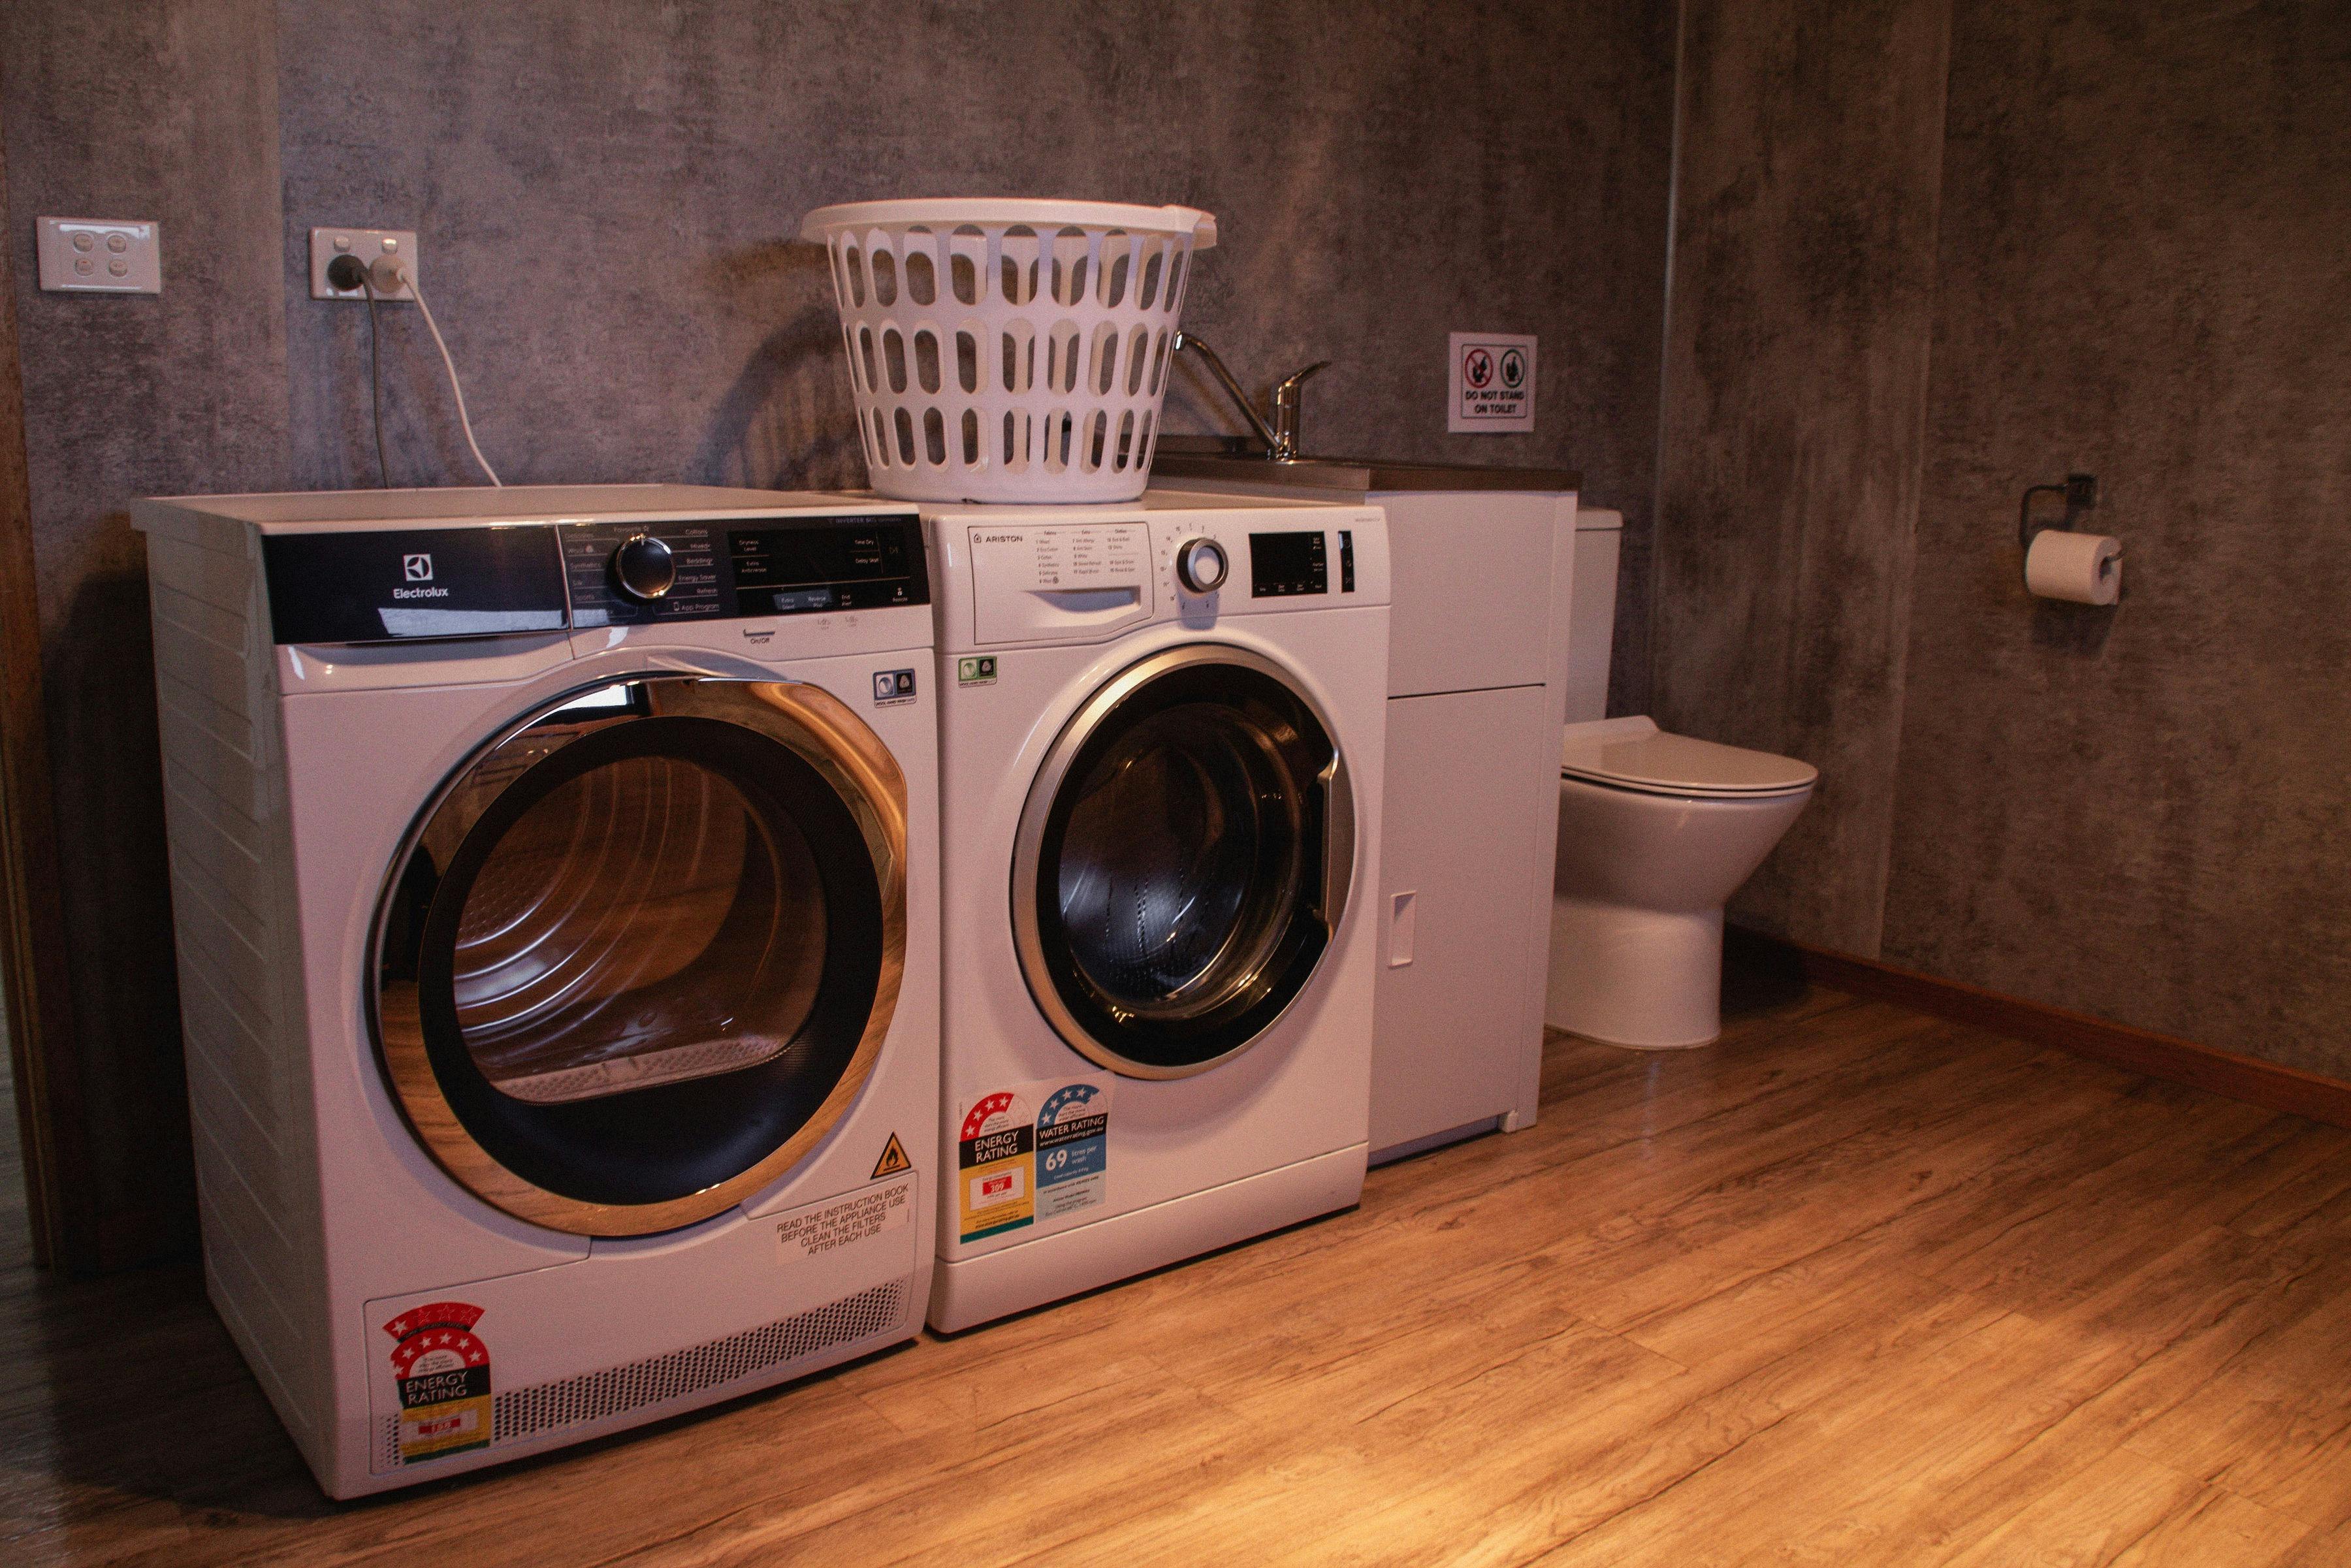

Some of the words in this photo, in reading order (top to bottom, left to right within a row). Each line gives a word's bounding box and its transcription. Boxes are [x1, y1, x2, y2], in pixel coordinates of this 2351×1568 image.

[1465, 391, 1479, 400] DO
[1480, 391, 1498, 400] NOT
[1499, 391, 1524, 400] STAND
[1475, 404, 1488, 413] ON
[1490, 404, 1518, 414] TOILET
[985, 535, 1023, 543] ARISTON
[393, 587, 449, 599] Electrolux
[1039, 1124, 1070, 1140] WATER
[1071, 1115, 1104, 1132] RATING
[975, 1130, 1019, 1151] ENERGY
[976, 1143, 1017, 1163] RATING
[1046, 1149, 1068, 1171] 69
[776, 1218, 802, 1234] READ
[805, 1211, 822, 1224] THE
[824, 1192, 882, 1219] INSTRUCTION
[884, 1183, 908, 1202] BOOK
[781, 1224, 818, 1243] BEFORE
[820, 1217, 837, 1230] THE
[839, 1202, 887, 1224] APPLIANCE
[889, 1194, 906, 1209] USE
[801, 1230, 831, 1248] CLEAN
[833, 1223, 850, 1236] THE
[852, 1212, 886, 1232] FILTERS
[808, 1240, 837, 1256] AFTER
[839, 1230, 862, 1246] EACH
[864, 1223, 882, 1237] USE
[406, 1371, 468, 1394] ENERGY
[408, 1384, 468, 1405] RATING
